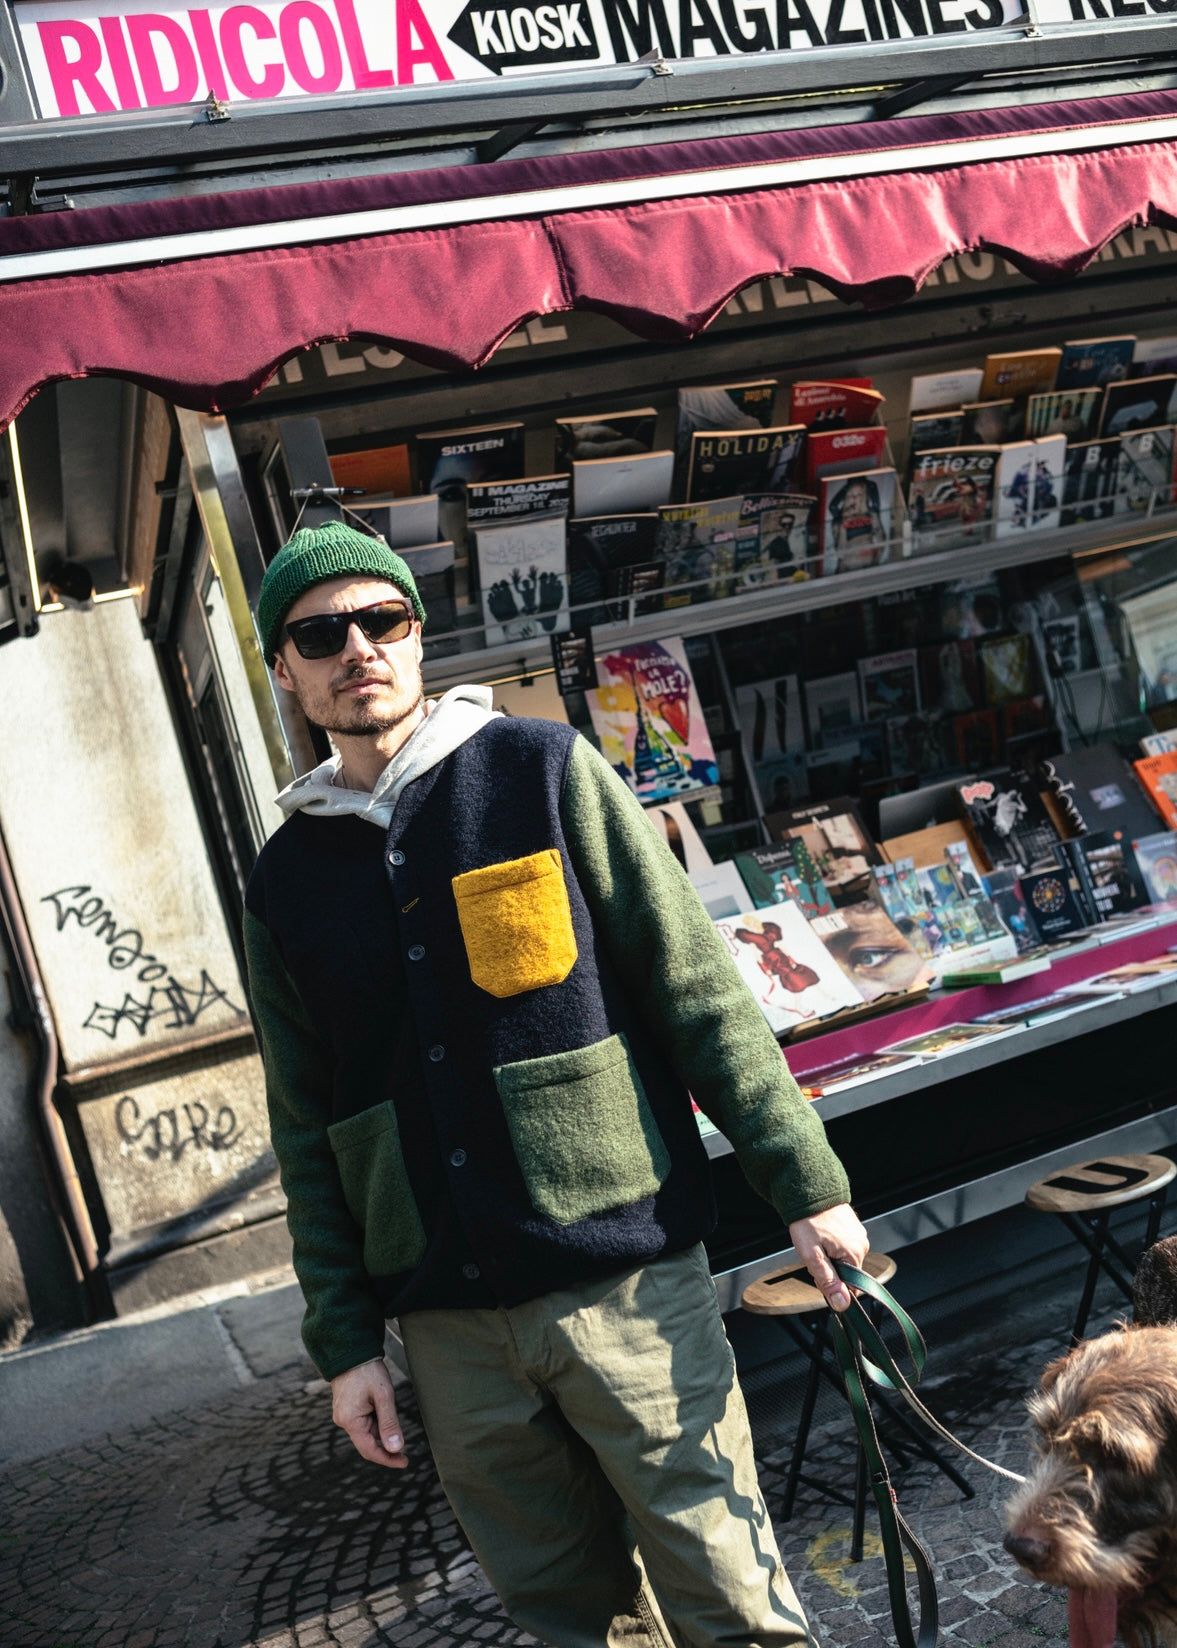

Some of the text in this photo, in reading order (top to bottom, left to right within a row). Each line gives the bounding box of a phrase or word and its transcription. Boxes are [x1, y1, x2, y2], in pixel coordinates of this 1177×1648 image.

[470, 2, 594, 56] KIOSK
[36, 0, 455, 117] RIDICOLA
[441, 438, 504, 456] SIXTEEN
[700, 432, 800, 458] HOLIDAY
[1142, 434, 1154, 453] B
[1086, 446, 1100, 465] B
[918, 455, 994, 478] frieze
[488, 481, 569, 496] MAGAZINE
[493, 492, 551, 507] THURSDAY
[466, 503, 531, 517] SEPTEMBER
[640, 670, 688, 700] MOLE?
